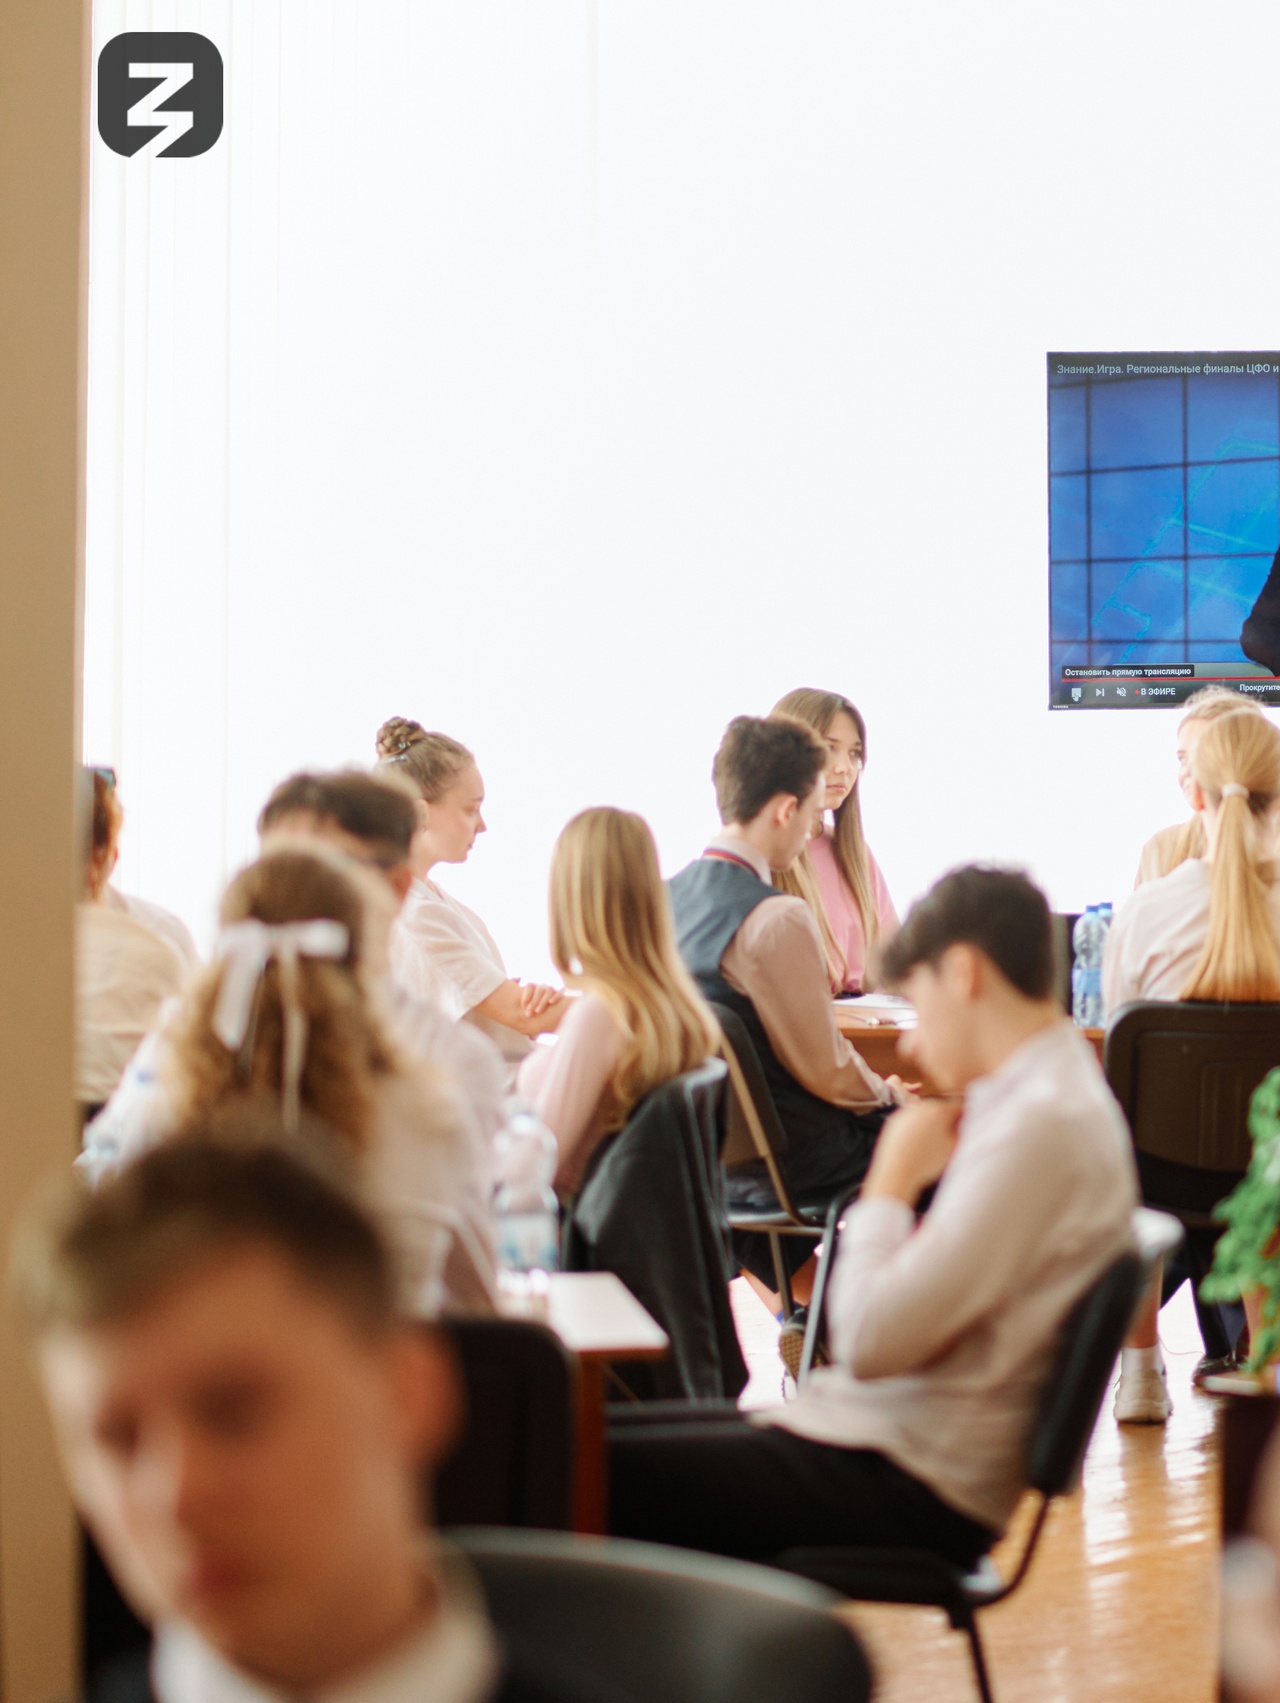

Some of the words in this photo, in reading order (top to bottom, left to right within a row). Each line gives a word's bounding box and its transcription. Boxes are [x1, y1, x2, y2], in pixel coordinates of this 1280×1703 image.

[1057, 364, 1124, 375] Знание.Игра.
[1126, 364, 1201, 374] Региональные
[1203, 363, 1244, 375] финалы
[1246, 363, 1270, 374] ЦФО
[1273, 365, 1279, 373] и
[1065, 668, 1110, 677] Остановить
[1112, 669, 1142, 678] прямую
[1144, 668, 1192, 677] трансляцию
[1148, 687, 1176, 696] ЭФИРЕ
[1239, 684, 1280, 693] Прокрутите
